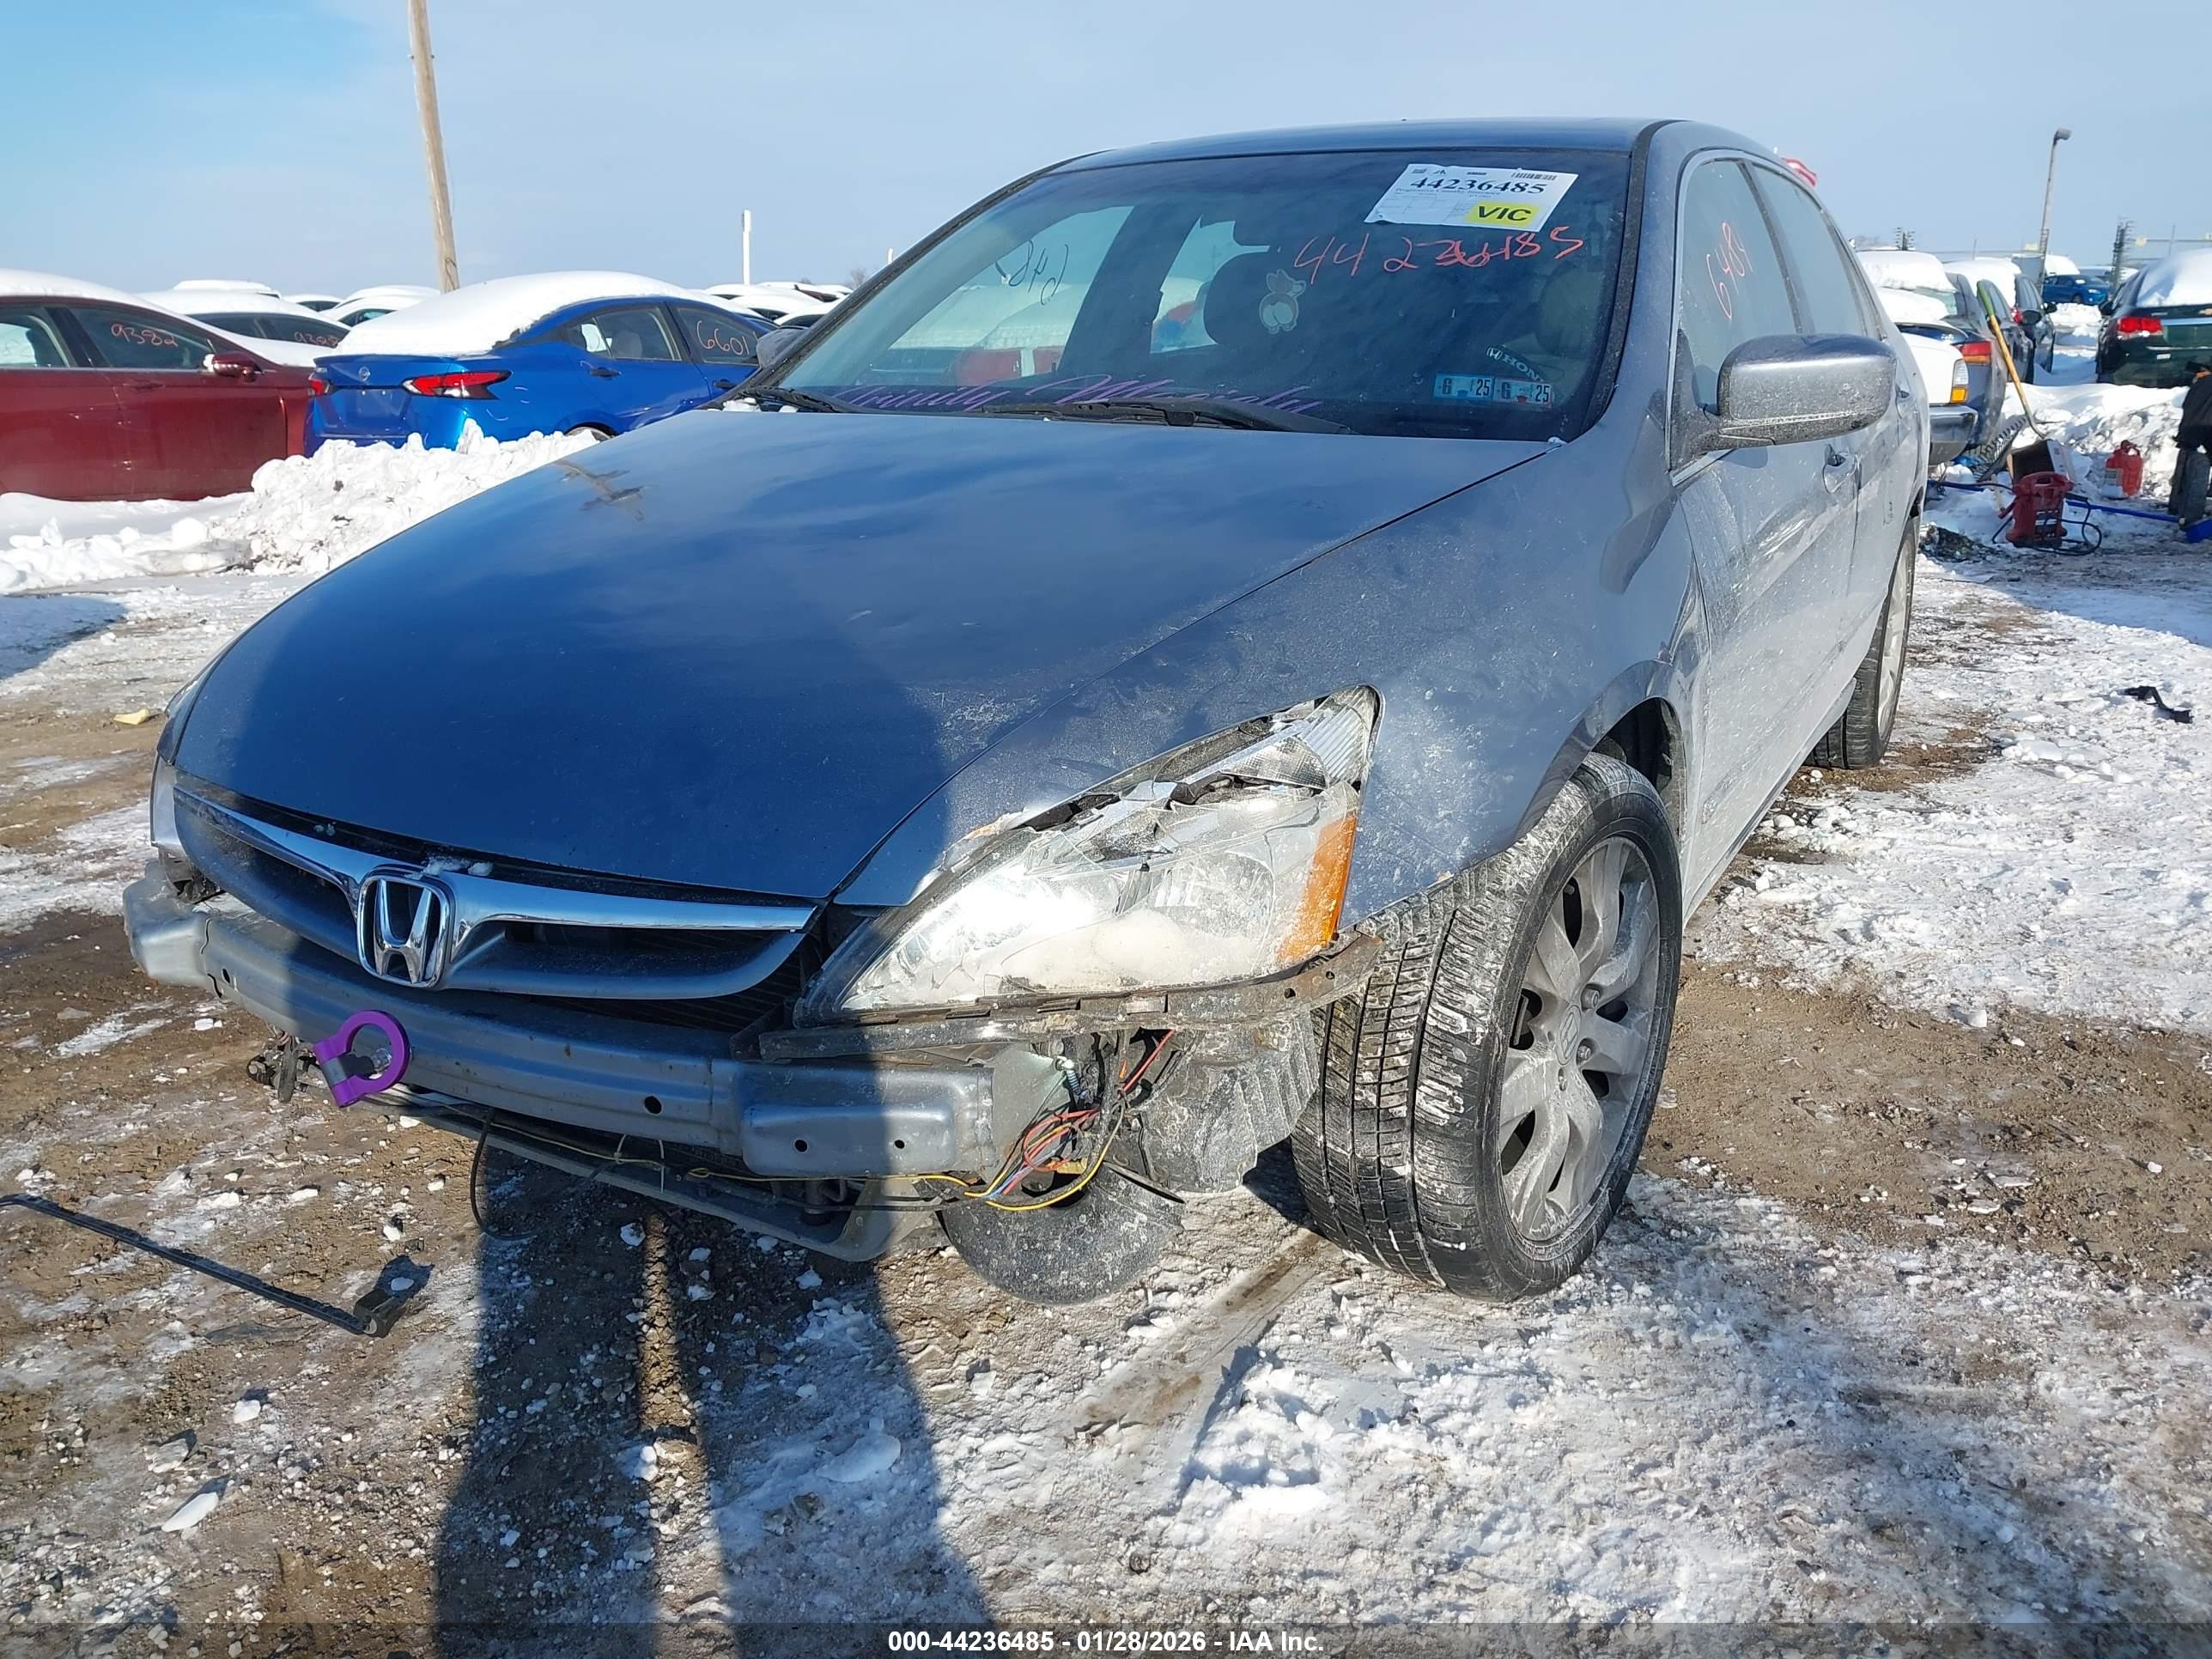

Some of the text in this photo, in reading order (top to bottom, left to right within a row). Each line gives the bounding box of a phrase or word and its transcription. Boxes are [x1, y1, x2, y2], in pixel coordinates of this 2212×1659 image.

[1411, 177, 1547, 194] 44236485
[1477, 205, 1532, 222] VIC
[696, 319, 750, 356] 6601
[1502, 354, 1544, 383] HON
[1475, 379, 1491, 396] 25
[1535, 385, 1551, 403] 25
